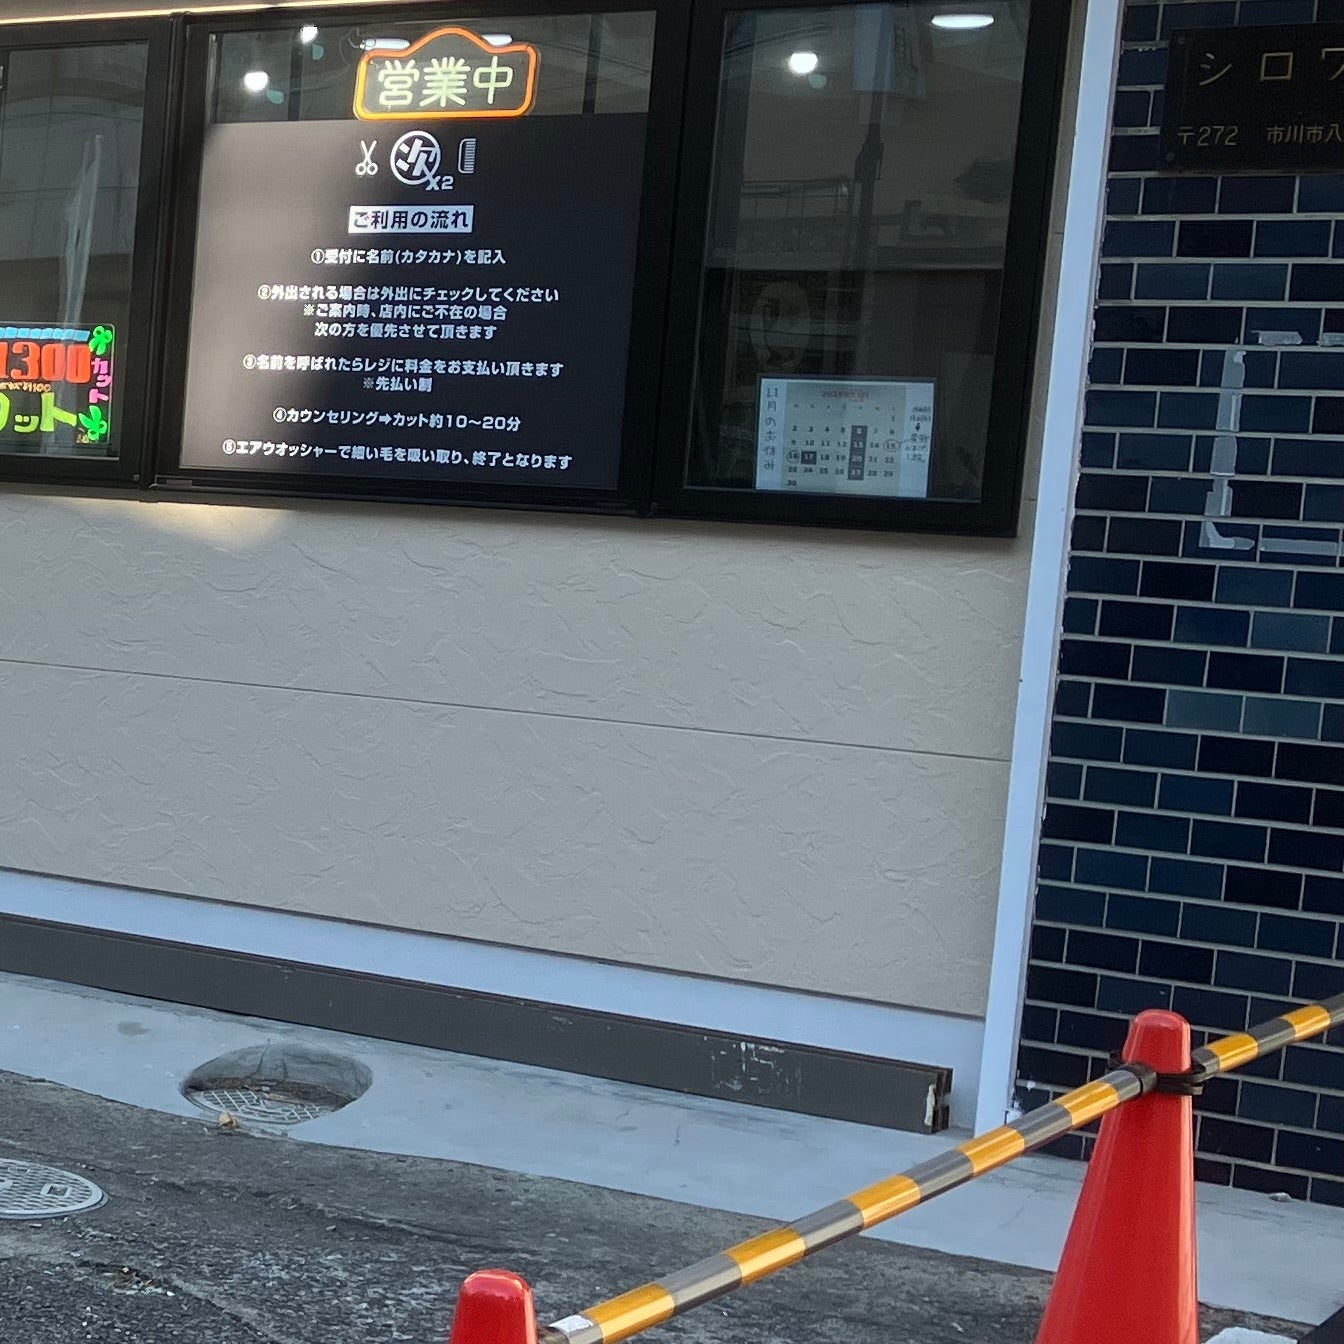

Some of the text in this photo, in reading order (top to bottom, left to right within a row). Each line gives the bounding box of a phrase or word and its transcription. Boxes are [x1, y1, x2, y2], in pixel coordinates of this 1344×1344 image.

[377, 56, 515, 108] 営業中
[354, 209, 469, 230] ご利用の流れ
[314, 321, 498, 340] 次の方を優先させて頂きます
[88, 358, 113, 404] カット
